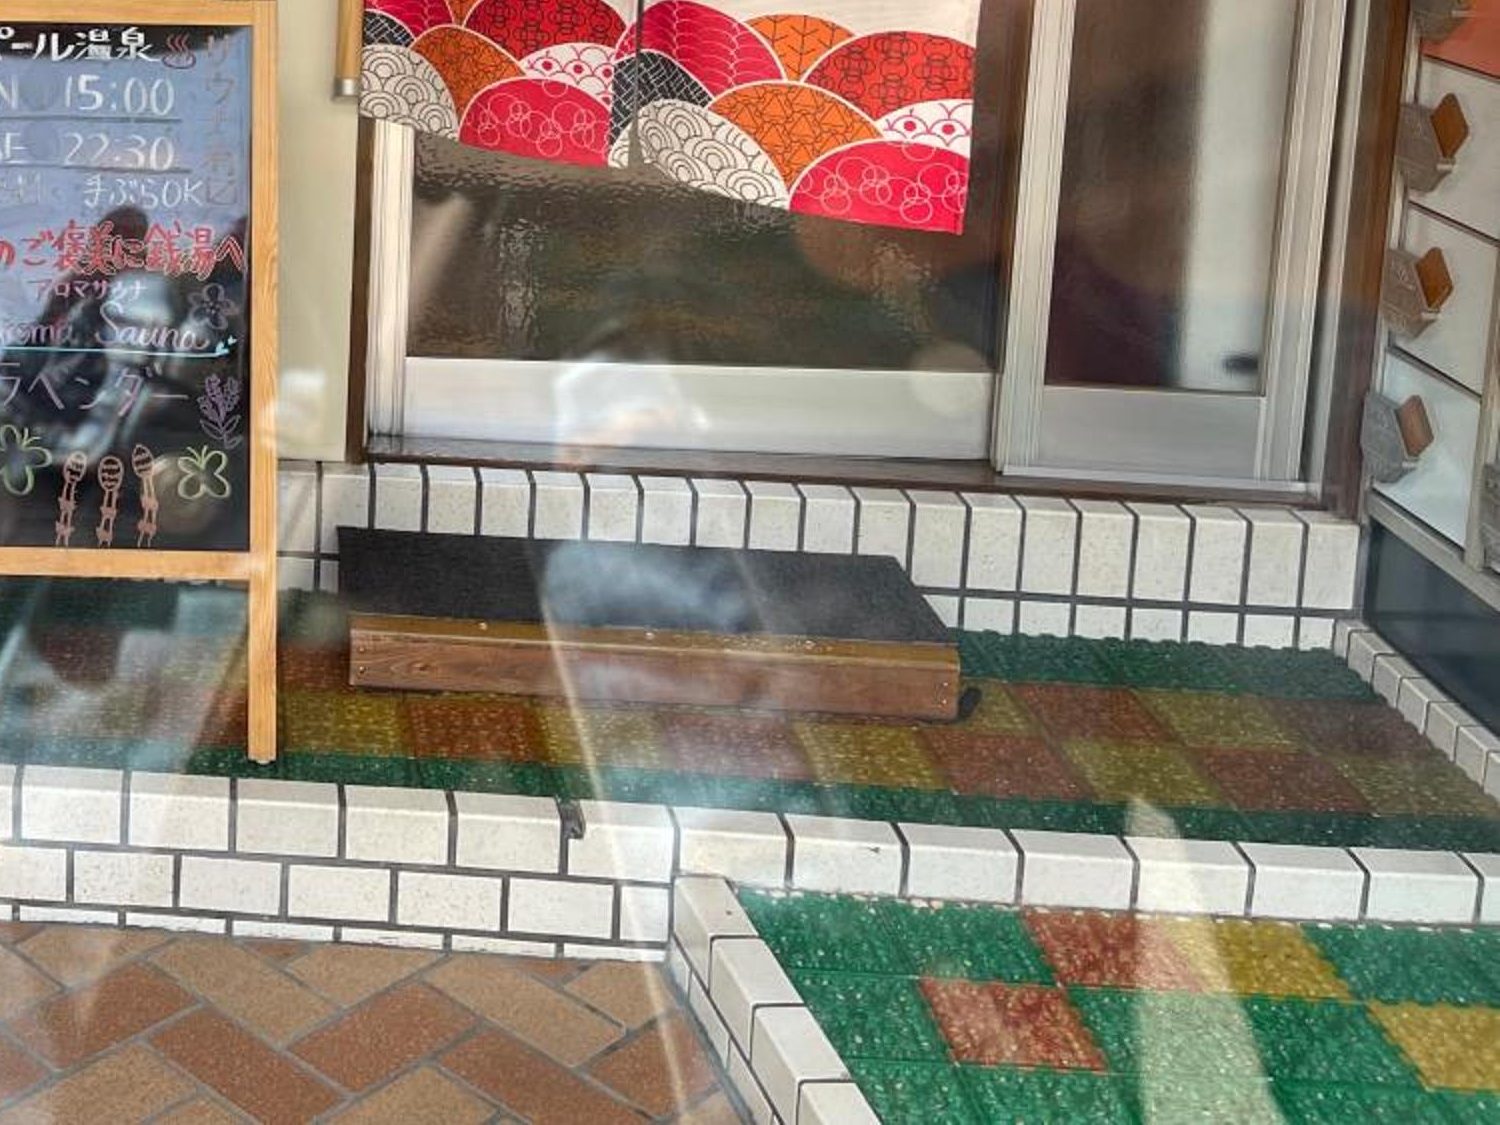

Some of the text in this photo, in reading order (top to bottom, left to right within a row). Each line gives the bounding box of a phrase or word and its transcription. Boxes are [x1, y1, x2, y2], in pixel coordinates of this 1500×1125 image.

[64, 75, 176, 116] 15:00
[63, 135, 176, 173] 22:30
[83, 177, 203, 208] 手ぶらOK
[34, 278, 149, 302] アロマサウナ
[96, 301, 211, 352] Sauna
